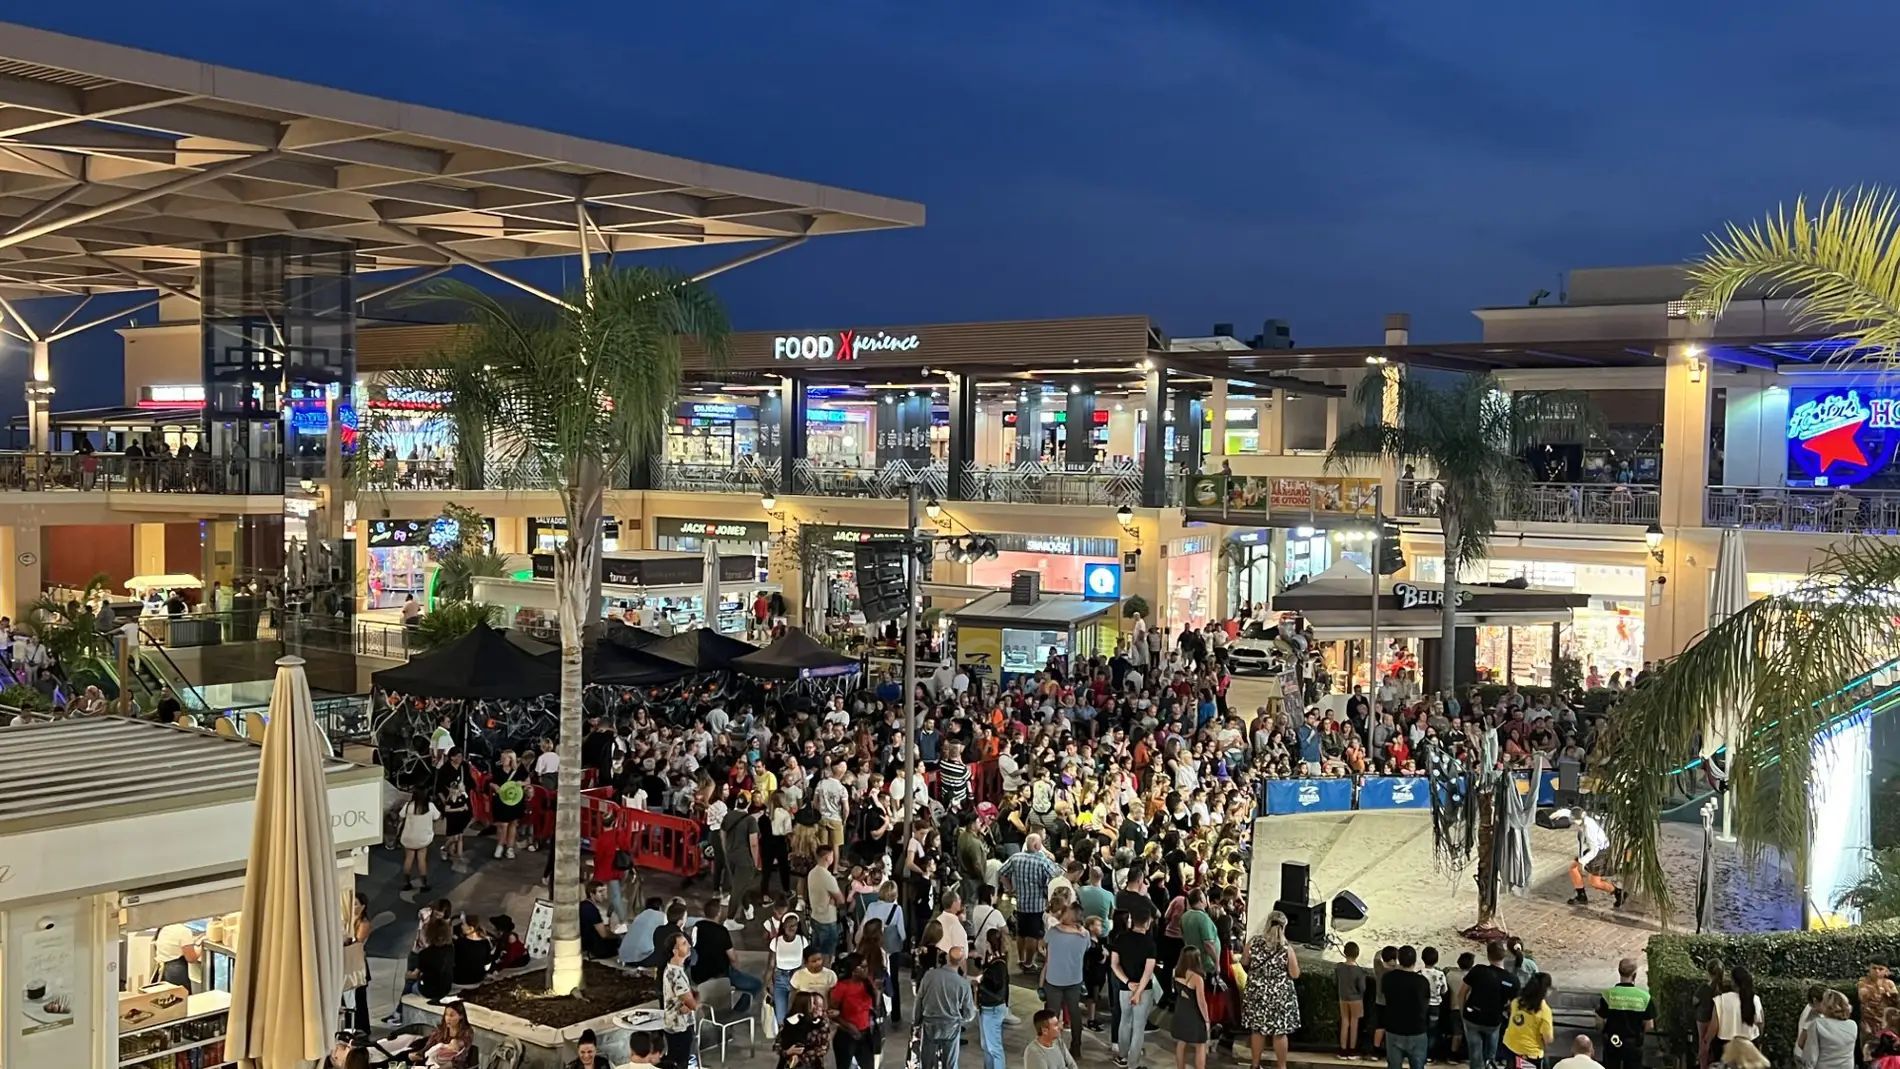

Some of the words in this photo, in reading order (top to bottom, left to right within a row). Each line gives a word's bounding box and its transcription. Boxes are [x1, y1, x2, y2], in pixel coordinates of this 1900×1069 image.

[775, 336, 834, 360] FOOD
[680, 523, 706, 533] JACK
[715, 525, 747, 536] JONES
[832, 531, 860, 542] JACK
[1394, 583, 1463, 608] BELRS
